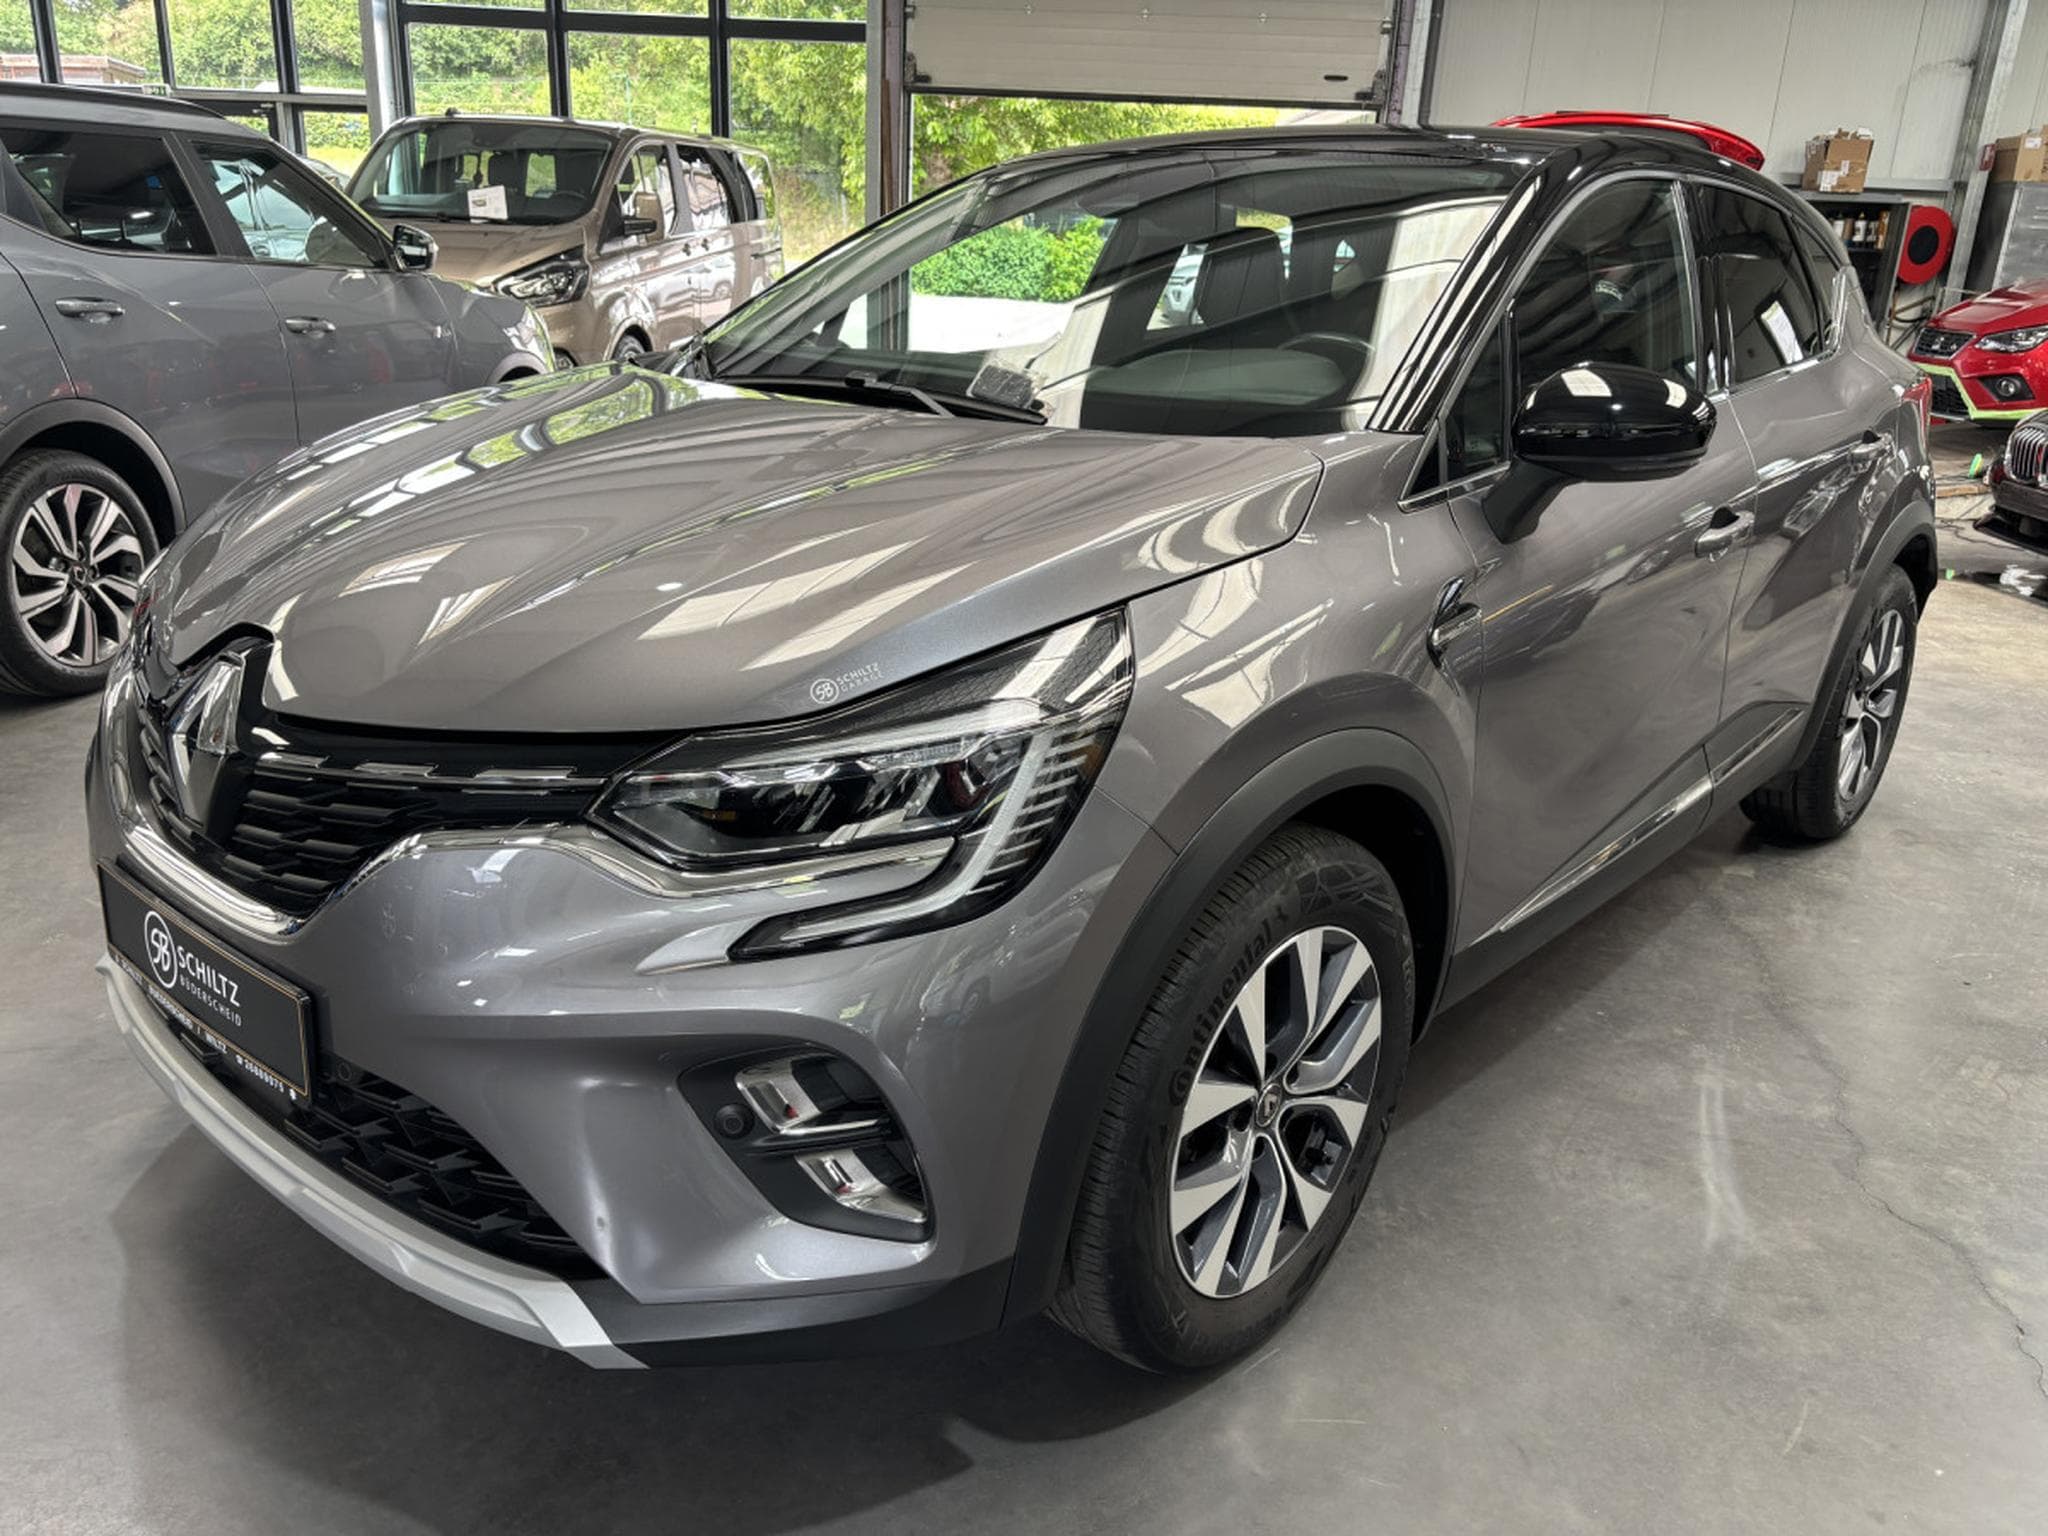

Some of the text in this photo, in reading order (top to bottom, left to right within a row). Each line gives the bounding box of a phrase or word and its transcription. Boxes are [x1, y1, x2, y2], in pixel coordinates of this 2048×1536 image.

[836, 662, 879, 685] SCHILTZ
[177, 945, 241, 1008] SCHILTZ
[1168, 917, 1272, 1106] Continental
